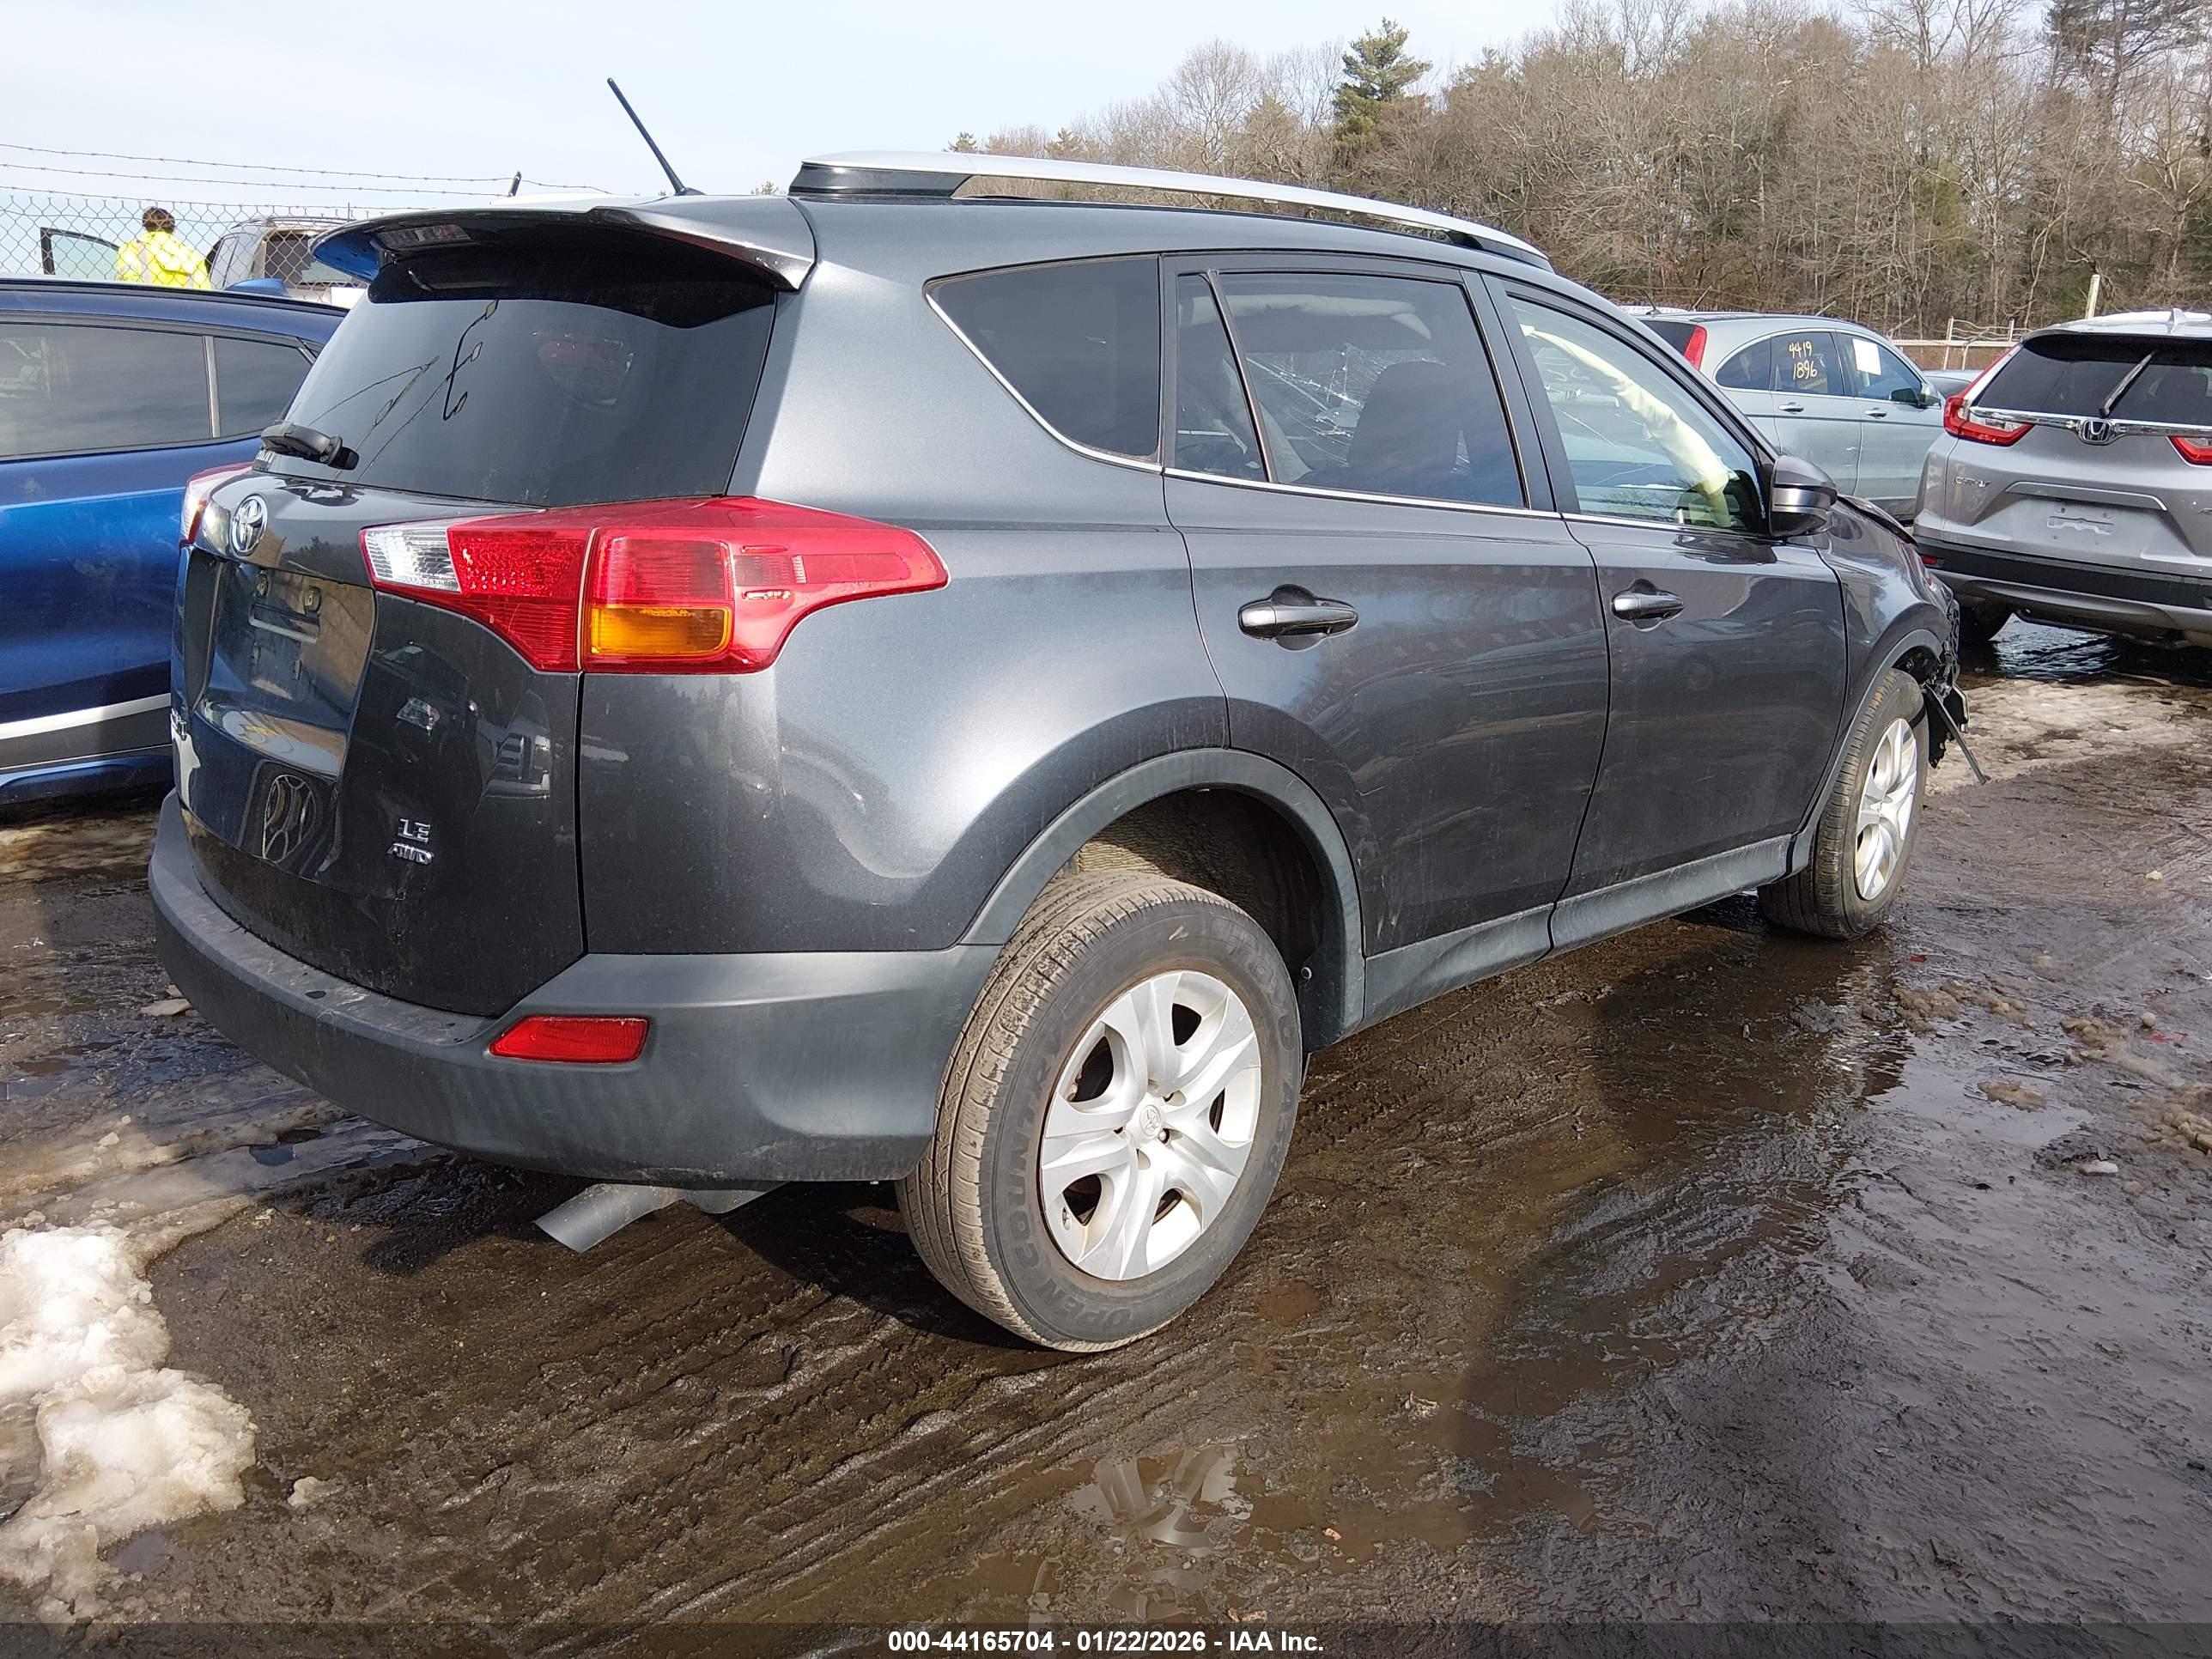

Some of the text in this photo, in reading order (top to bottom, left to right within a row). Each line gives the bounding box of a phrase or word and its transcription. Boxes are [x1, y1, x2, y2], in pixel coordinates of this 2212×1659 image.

[1789, 341, 1812, 358] 4419
[1793, 360, 1818, 380] 1896
[398, 818, 431, 843] LE
[387, 842, 433, 865] AWD
